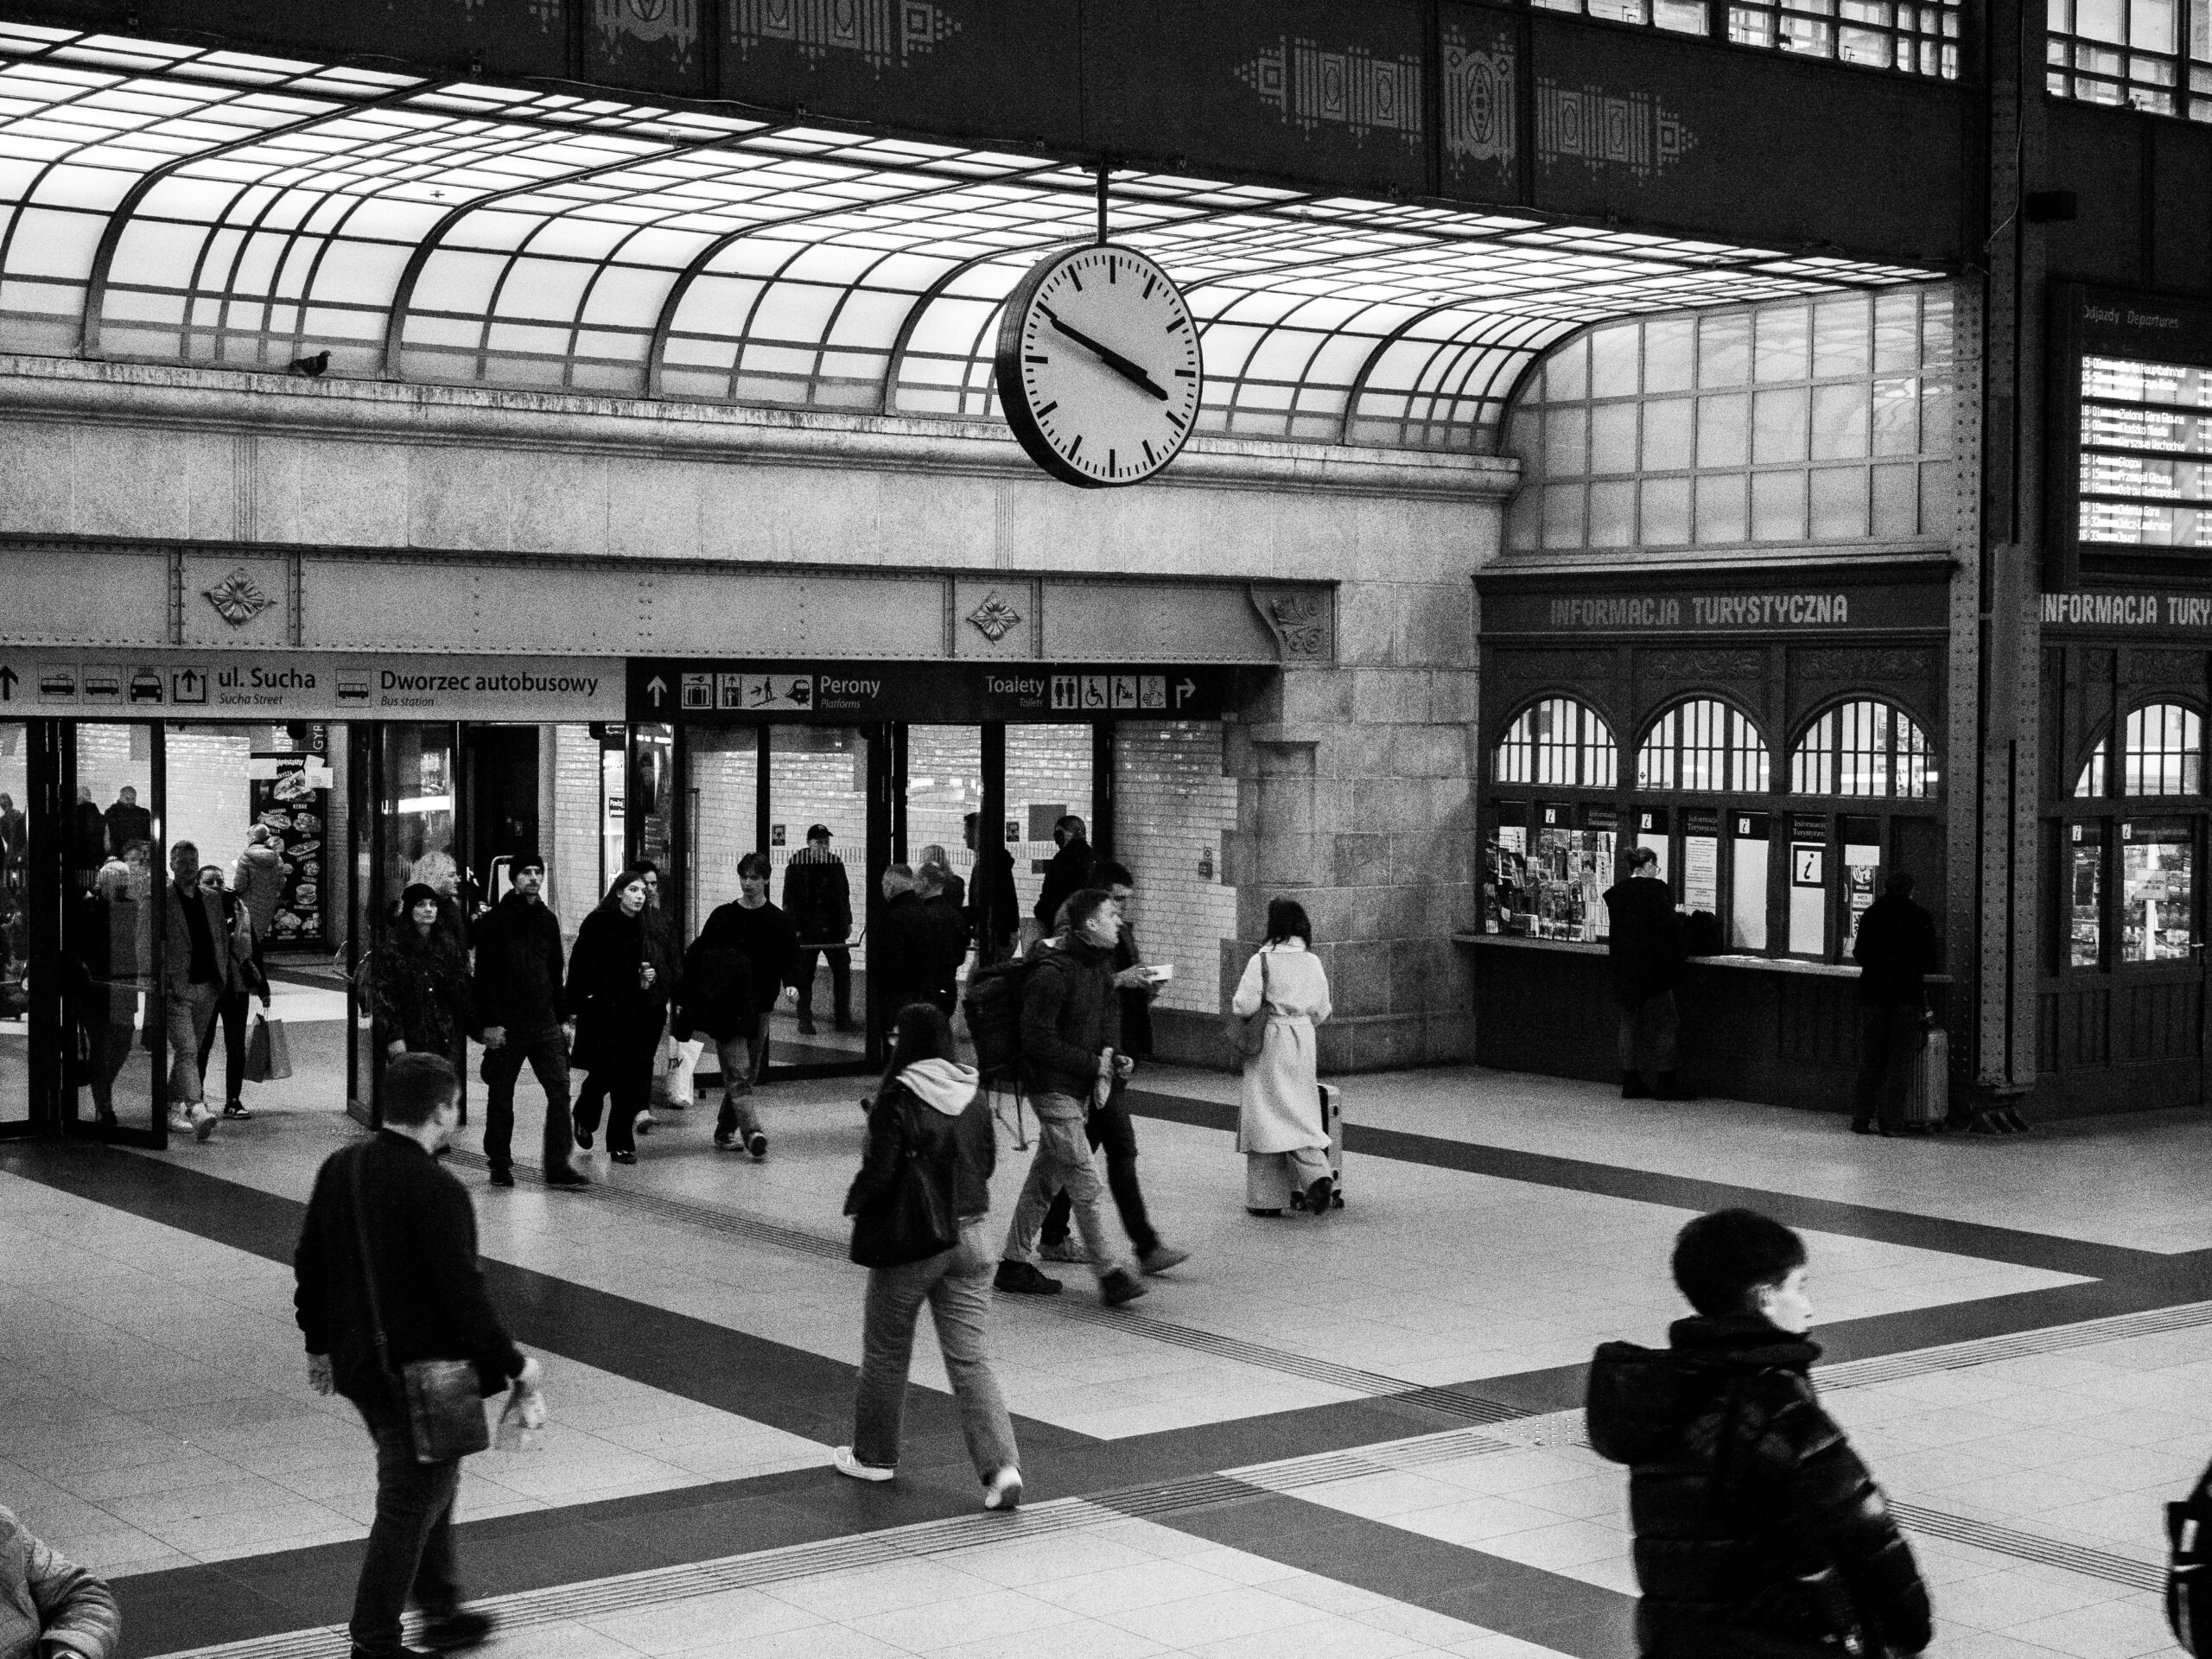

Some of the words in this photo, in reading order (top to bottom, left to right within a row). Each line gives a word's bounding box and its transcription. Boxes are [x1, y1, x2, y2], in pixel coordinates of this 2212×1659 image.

[2081, 405, 2101, 417] 16:01
[2081, 433, 2101, 444] 16:10
[1551, 598, 1680, 626] INFORMACJA
[1693, 594, 1847, 624] TURYSTYCZNA
[2040, 594, 2158, 624] INFORMACJA
[2167, 596, 2212, 626] TURY
[218, 666, 245, 688] ul.
[251, 666, 316, 689] Sucha
[380, 670, 470, 691] Dworzec
[474, 671, 599, 697] autobusowy
[985, 675, 1046, 697] Toalety
[820, 675, 881, 698] Perony
[219, 693, 251, 705] Sucha
[253, 694, 284, 705] Street
[380, 696, 398, 707] Bus
[400, 696, 435, 708] station
[820, 698, 861, 709] Platforms
[1019, 697, 1045, 708] Toilets
